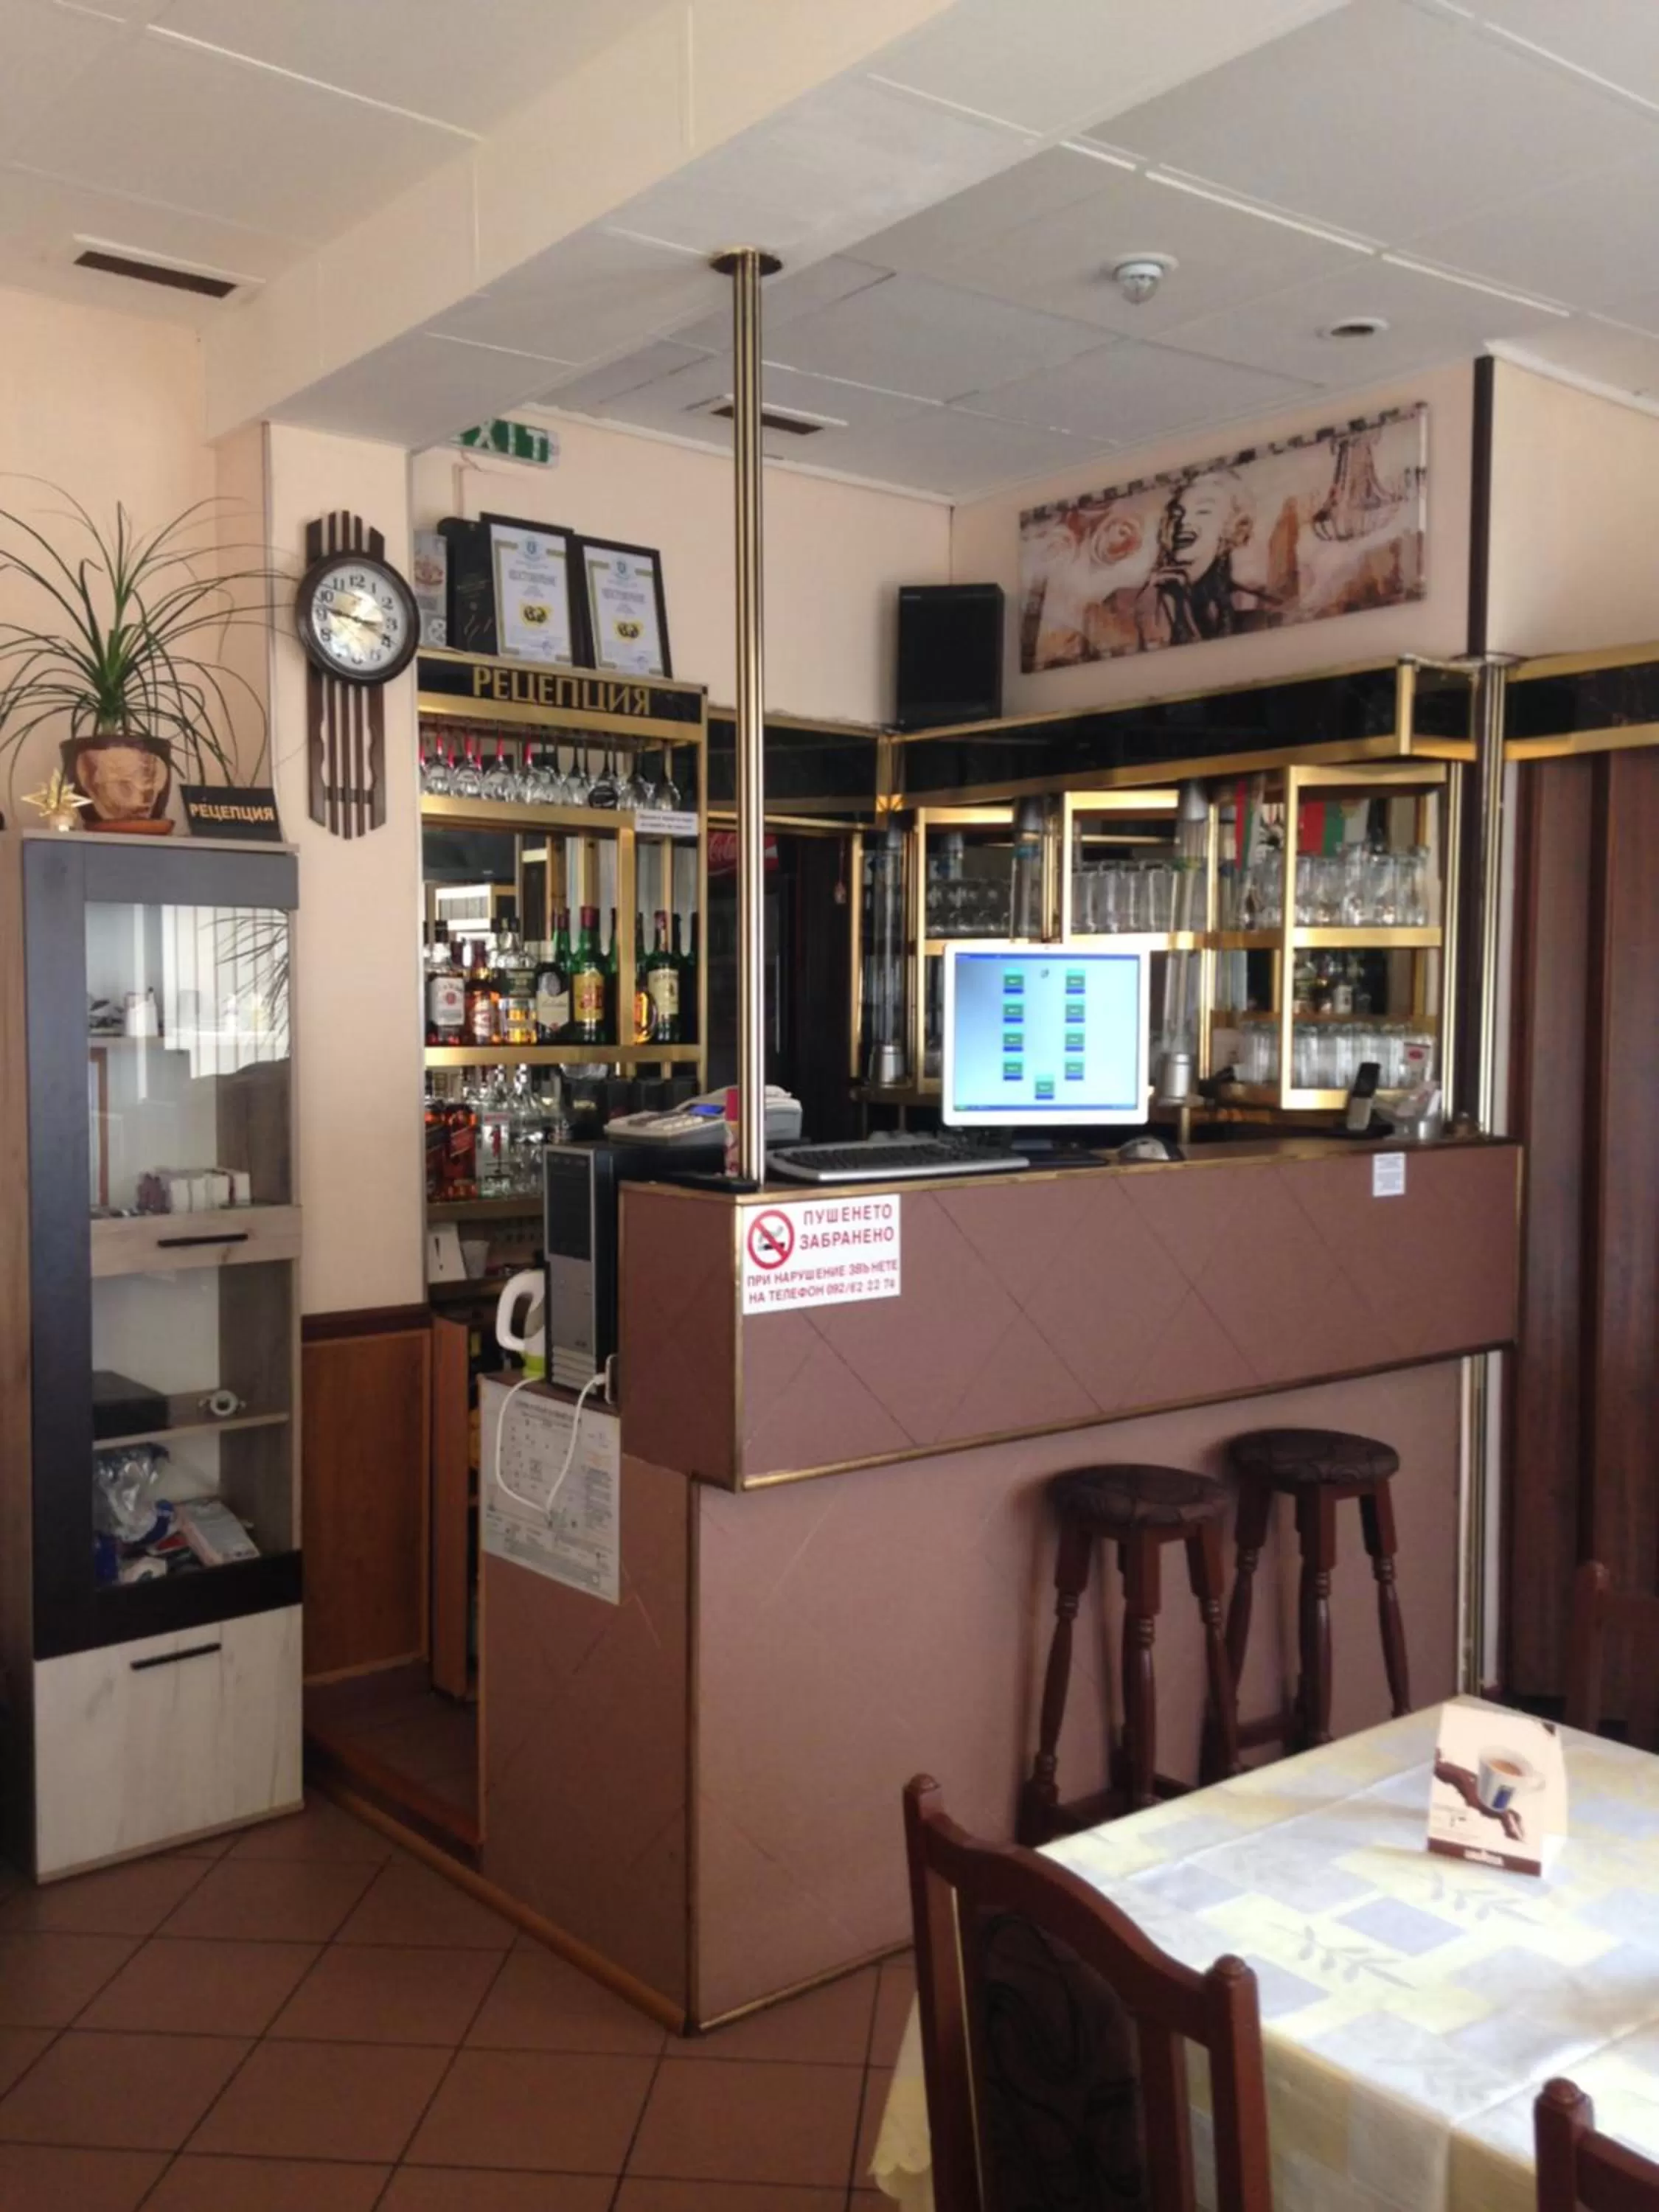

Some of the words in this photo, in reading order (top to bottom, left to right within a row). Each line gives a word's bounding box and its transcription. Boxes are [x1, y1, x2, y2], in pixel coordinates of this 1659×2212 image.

[449, 418, 547, 462] XIT
[333, 577, 345, 591] 11
[349, 574, 366, 588] 12
[371, 582, 377, 594] 1
[320, 590, 334, 603] 10
[381, 597, 394, 611] 2
[316, 605, 327, 621] 9
[386, 617, 398, 631] 3
[473, 666, 650, 716] РЕЦЕПЦИЯ
[189, 803, 275, 824] РЕЦЕПЦИЯ
[804, 1203, 893, 1225] ПУШЕНЕТО
[799, 1226, 894, 1251] ЗАБРАНЕНО
[747, 1274, 771, 1287] ПРИ
[773, 1265, 846, 1284] НАРУШЕНИЕ
[748, 1291, 765, 1304] НА
[769, 1285, 824, 1302] ТЕЛЕФОН
